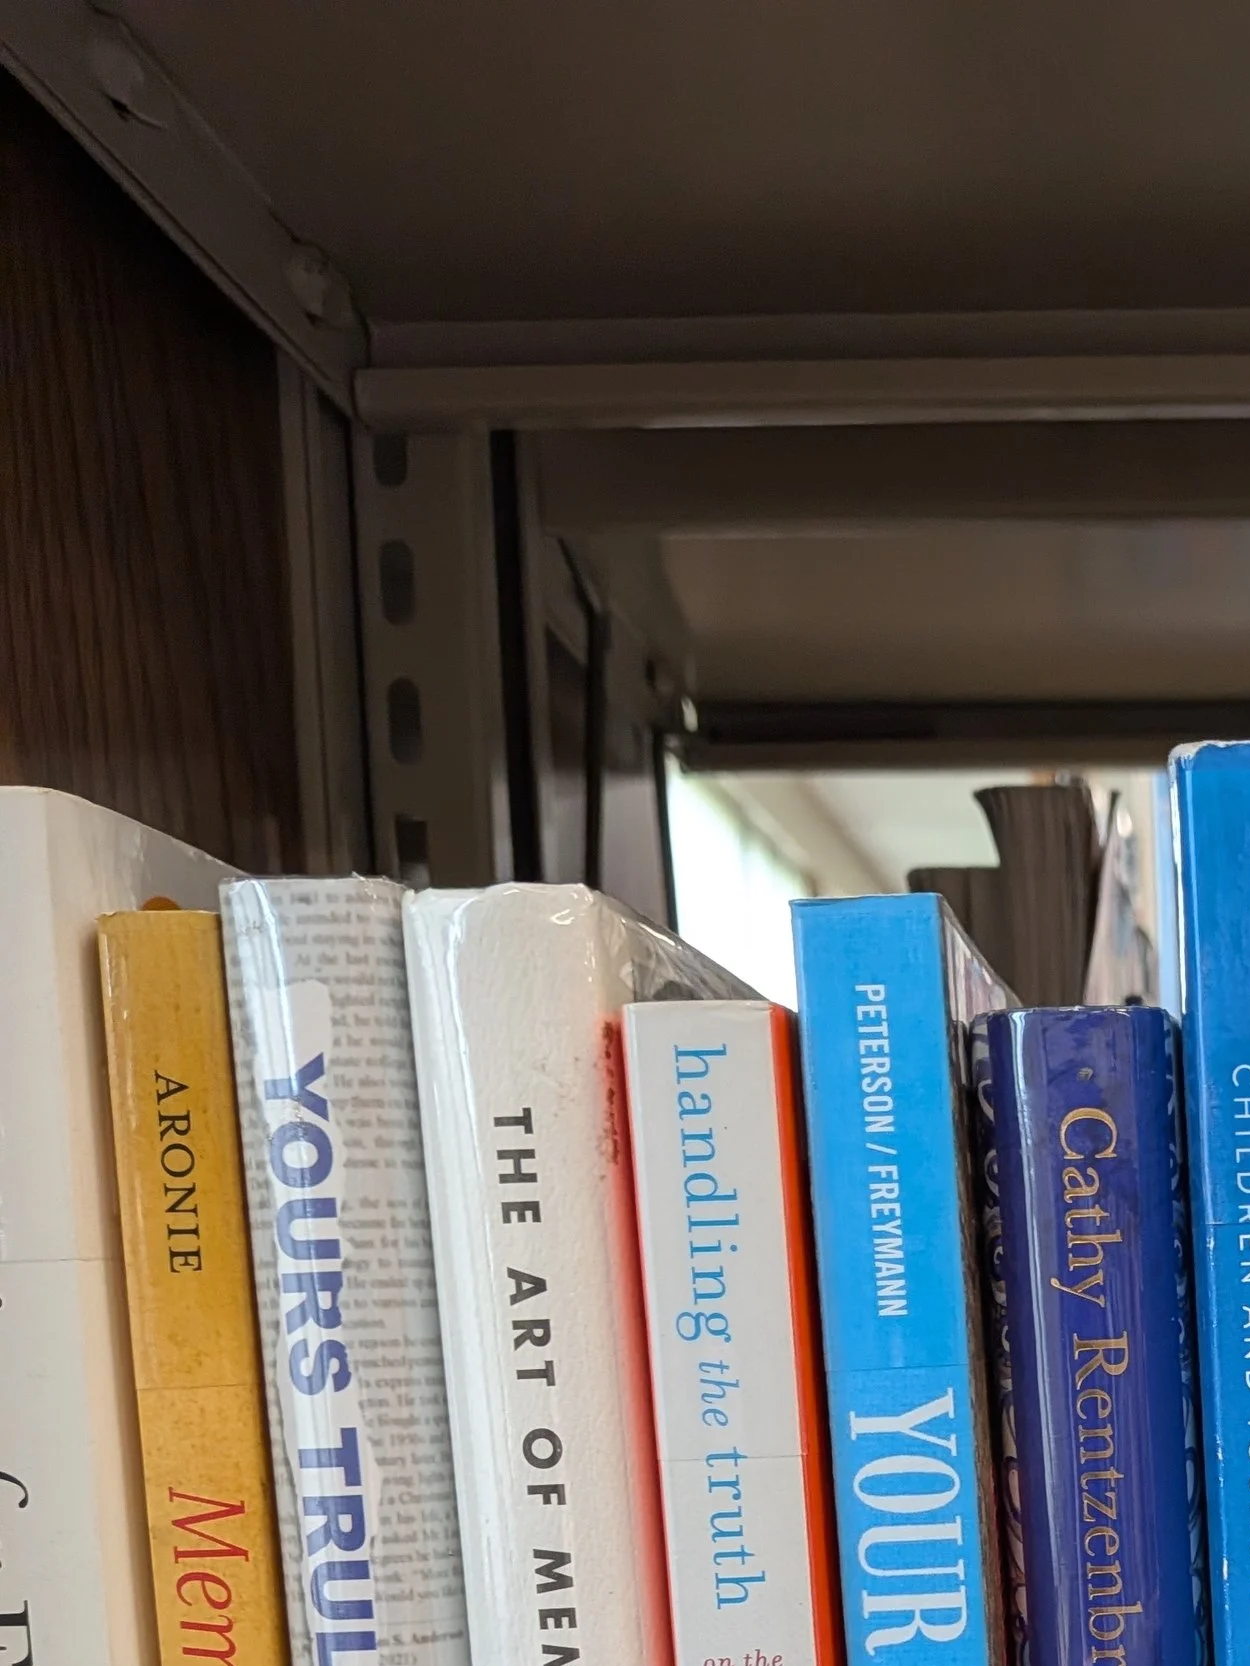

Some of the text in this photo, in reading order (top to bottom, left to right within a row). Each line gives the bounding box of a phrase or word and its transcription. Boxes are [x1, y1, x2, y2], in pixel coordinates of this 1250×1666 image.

[153, 1069, 204, 1275] ARONIE
[262, 1051, 354, 1397] YOURS
[493, 1106, 543, 1227] THE
[854, 984, 909, 1318] PETERSON FREYMANN
[1050, 1106, 1123, 1308] Cathy
[505, 1266, 557, 1388] ART
[673, 1042, 766, 1610] handling the truth
[521, 1426, 567, 1506] OF
[848, 1387, 968, 1657] YOUR
